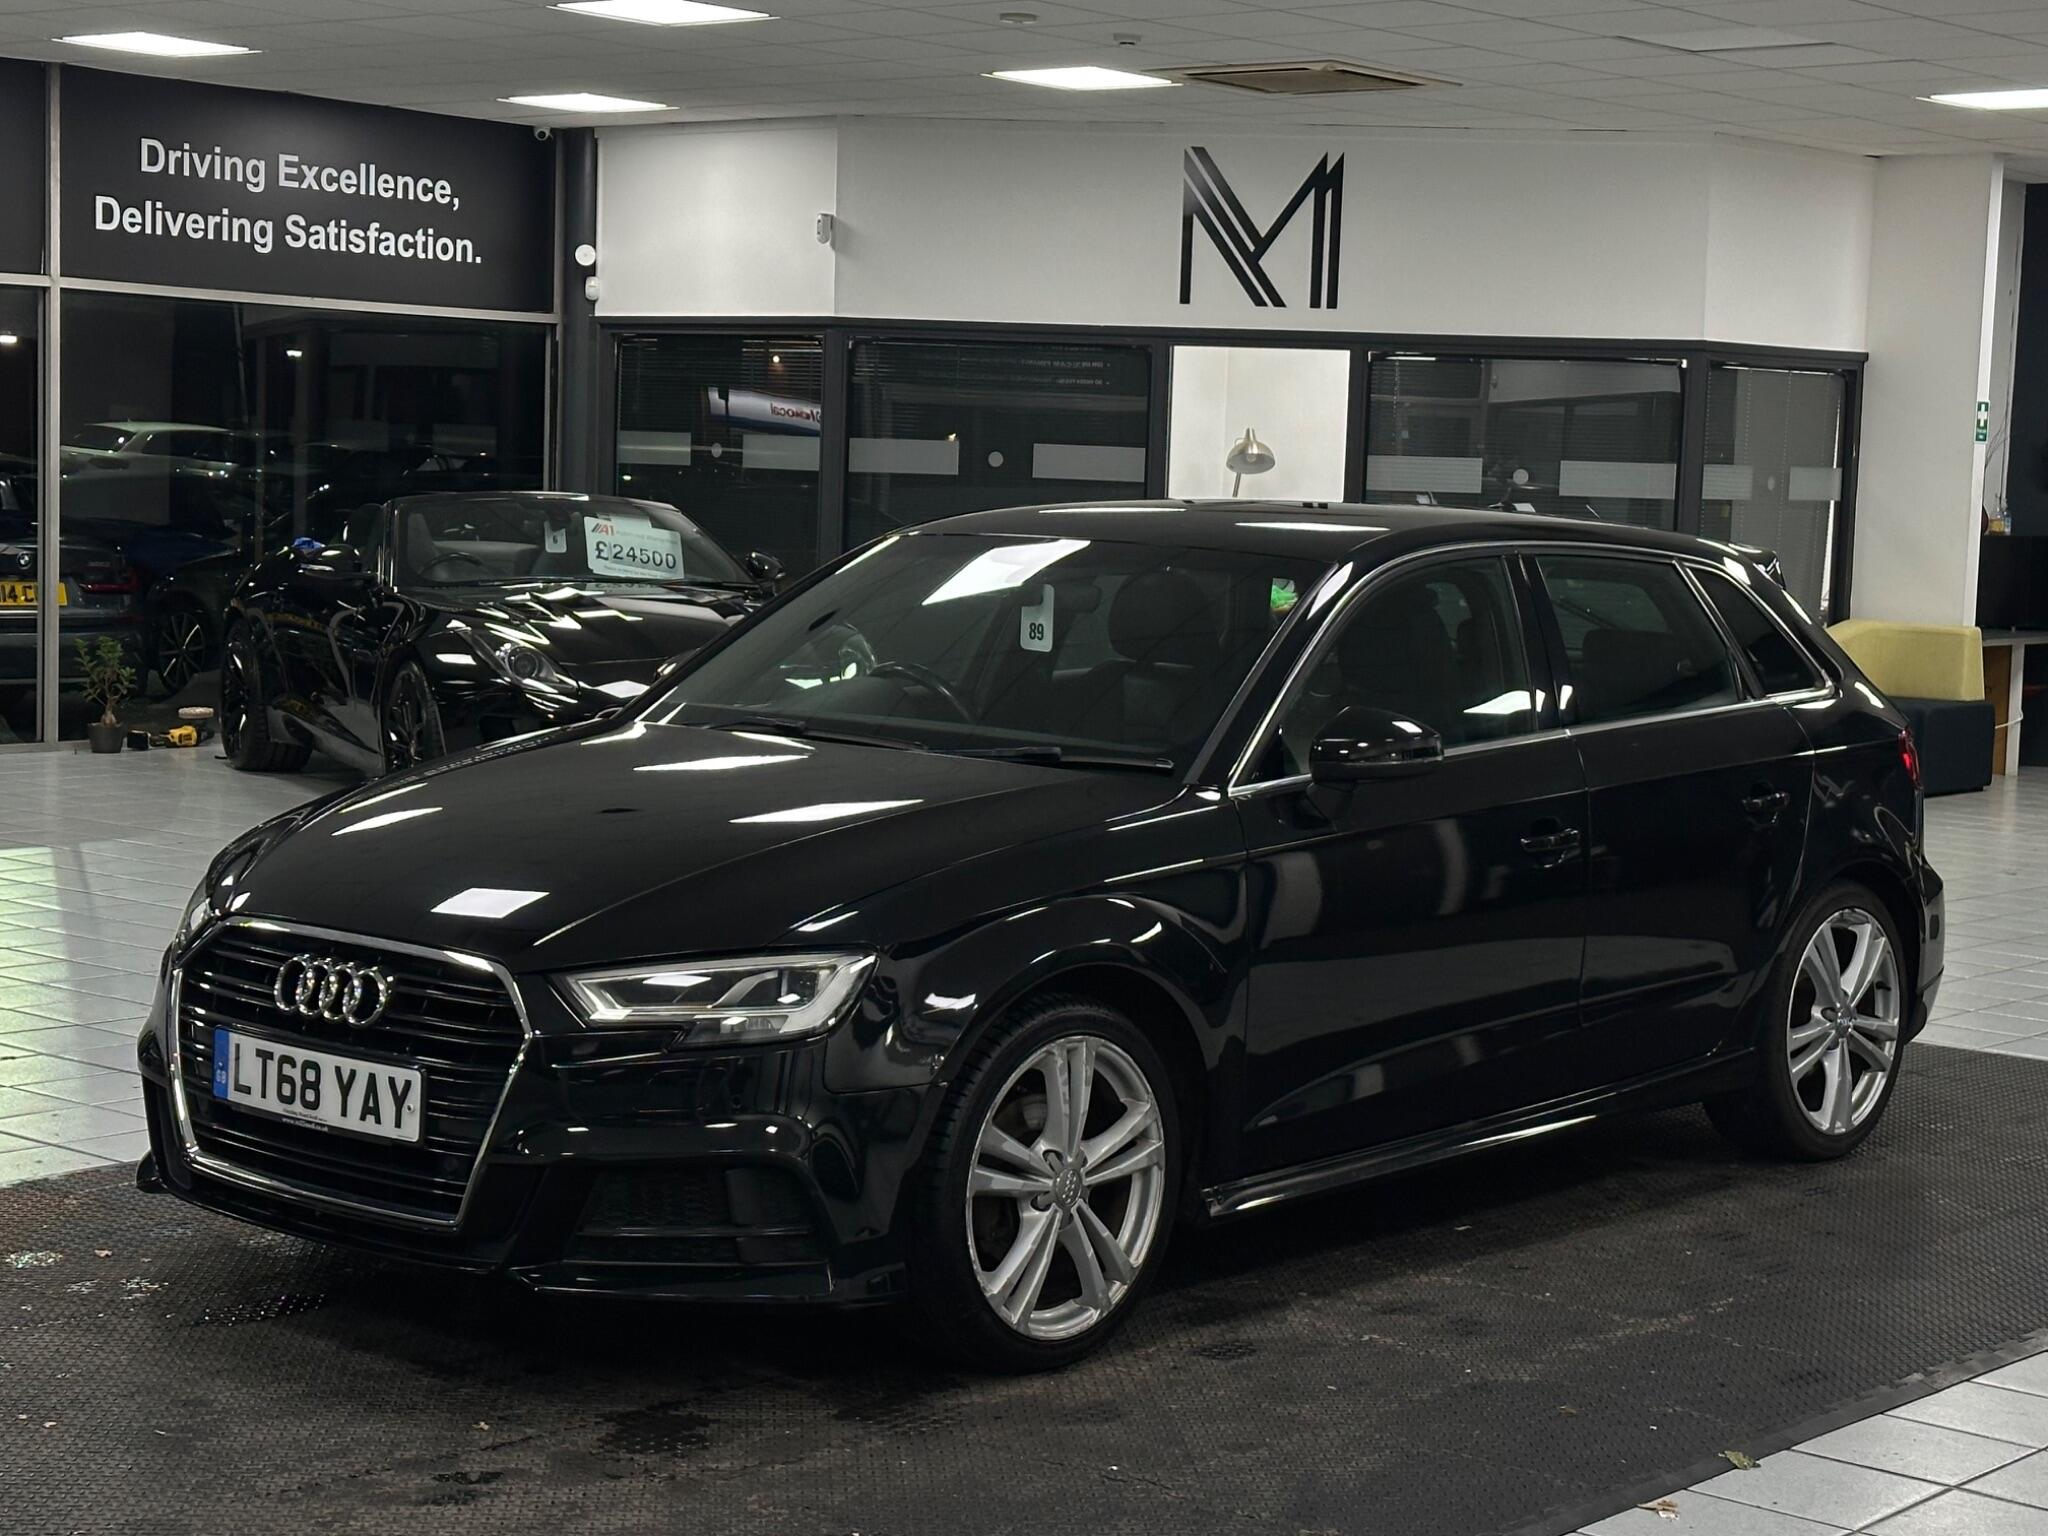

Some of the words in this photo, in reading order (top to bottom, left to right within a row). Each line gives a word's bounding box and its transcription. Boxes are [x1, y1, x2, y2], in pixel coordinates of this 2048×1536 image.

[140, 137, 266, 193] Driving
[278, 152, 460, 211] Excellence,
[94, 195, 273, 254] Delivering
[284, 213, 482, 264] Satisfaction.
[594, 540, 677, 570] £24500
[1029, 622, 1044, 641] 89
[233, 1043, 321, 1111] LT68
[334, 1065, 412, 1129] YAY
